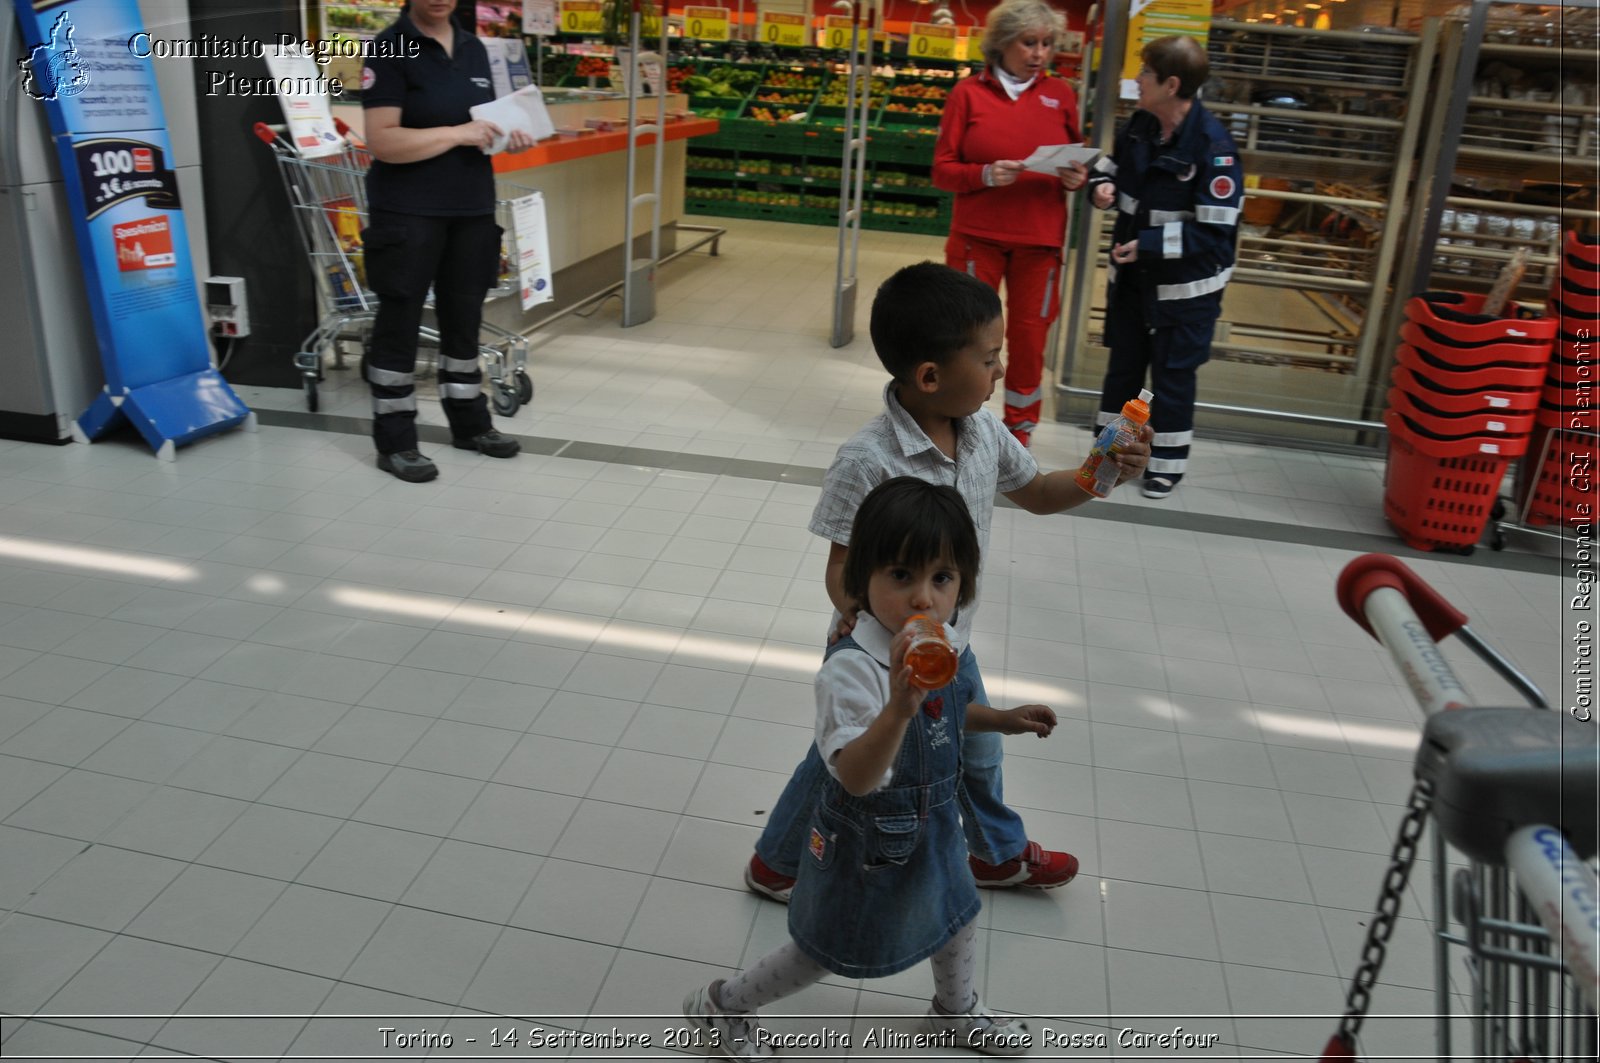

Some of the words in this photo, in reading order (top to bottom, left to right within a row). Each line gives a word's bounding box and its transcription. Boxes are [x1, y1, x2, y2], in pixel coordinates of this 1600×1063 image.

[692, 19, 702, 37] 0
[768, 24, 779, 42] 0
[832, 29, 843, 47] 0
[916, 36, 928, 55] 0
[90, 149, 133, 177] 100
